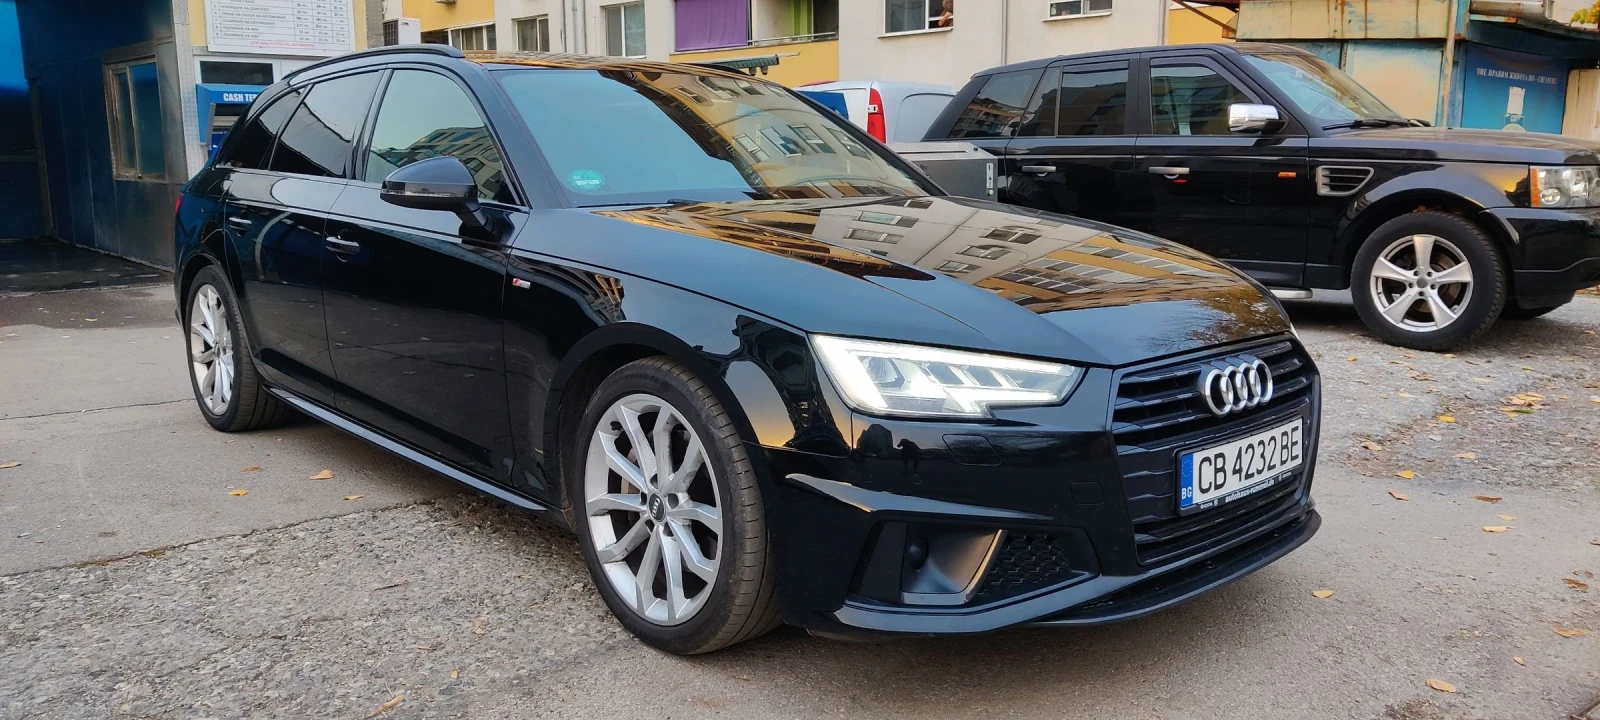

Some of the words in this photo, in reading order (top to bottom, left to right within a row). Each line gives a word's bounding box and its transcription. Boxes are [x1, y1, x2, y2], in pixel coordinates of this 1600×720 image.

[223, 93, 244, 102] CASH
[1199, 452, 1227, 494] CB
[1232, 436, 1276, 482] 4232
[1280, 426, 1299, 466] BE
[1181, 486, 1192, 499] BG
